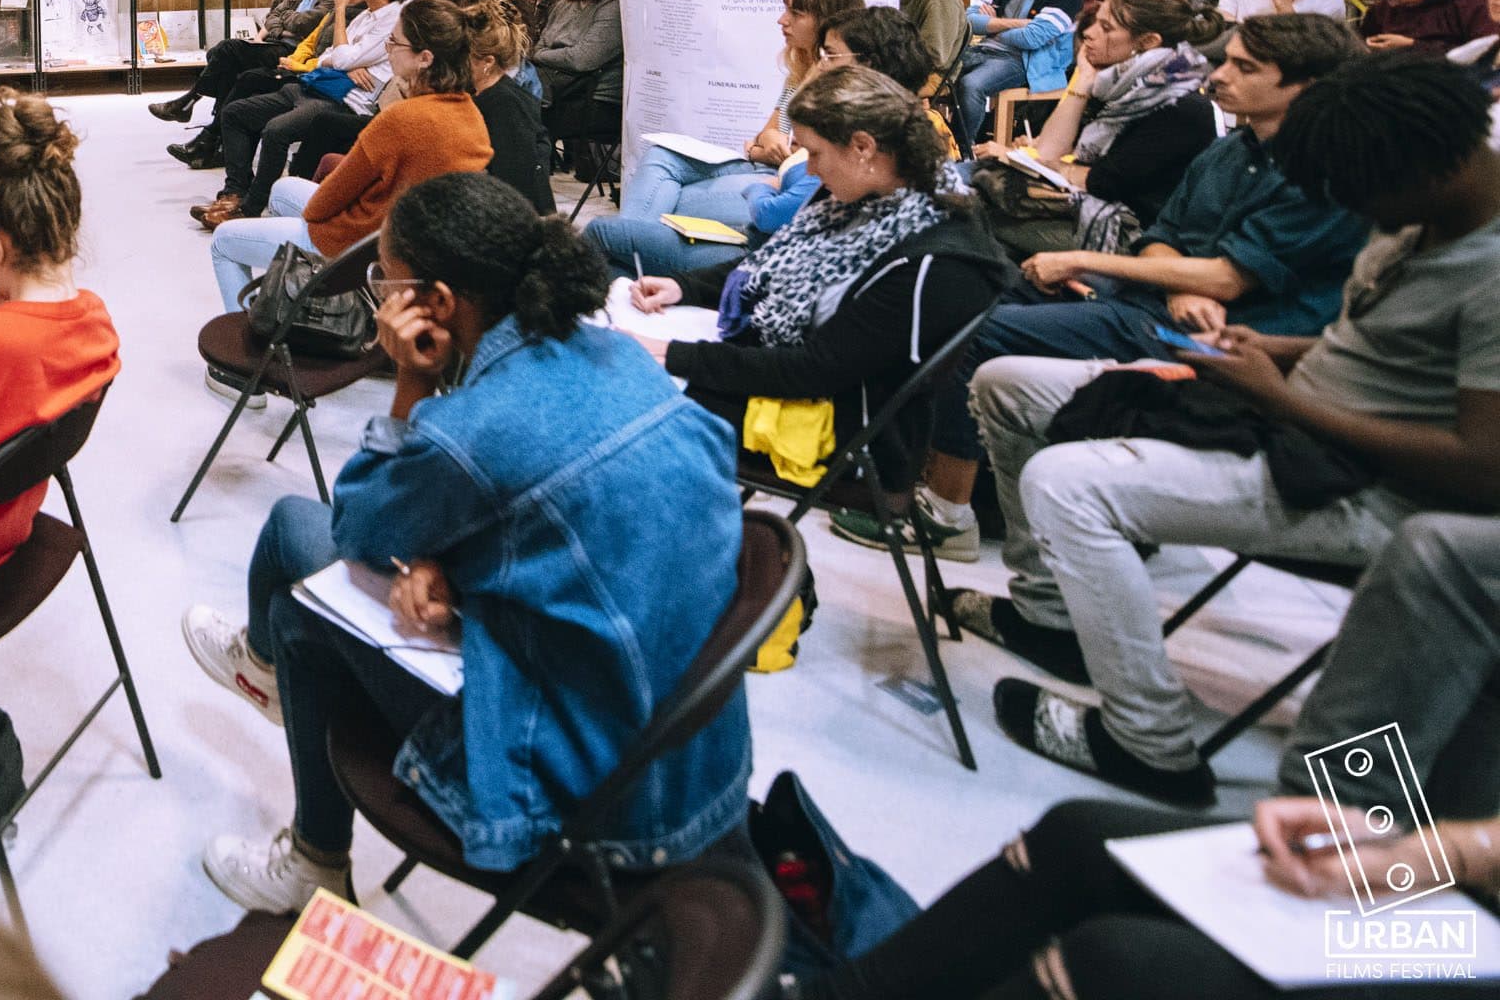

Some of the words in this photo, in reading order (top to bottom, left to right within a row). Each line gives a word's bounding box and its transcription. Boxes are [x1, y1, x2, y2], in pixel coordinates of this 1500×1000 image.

[721, 4, 764, 13] Worrying's
[708, 80, 738, 89] FUNERAL
[739, 82, 761, 91] HOME
